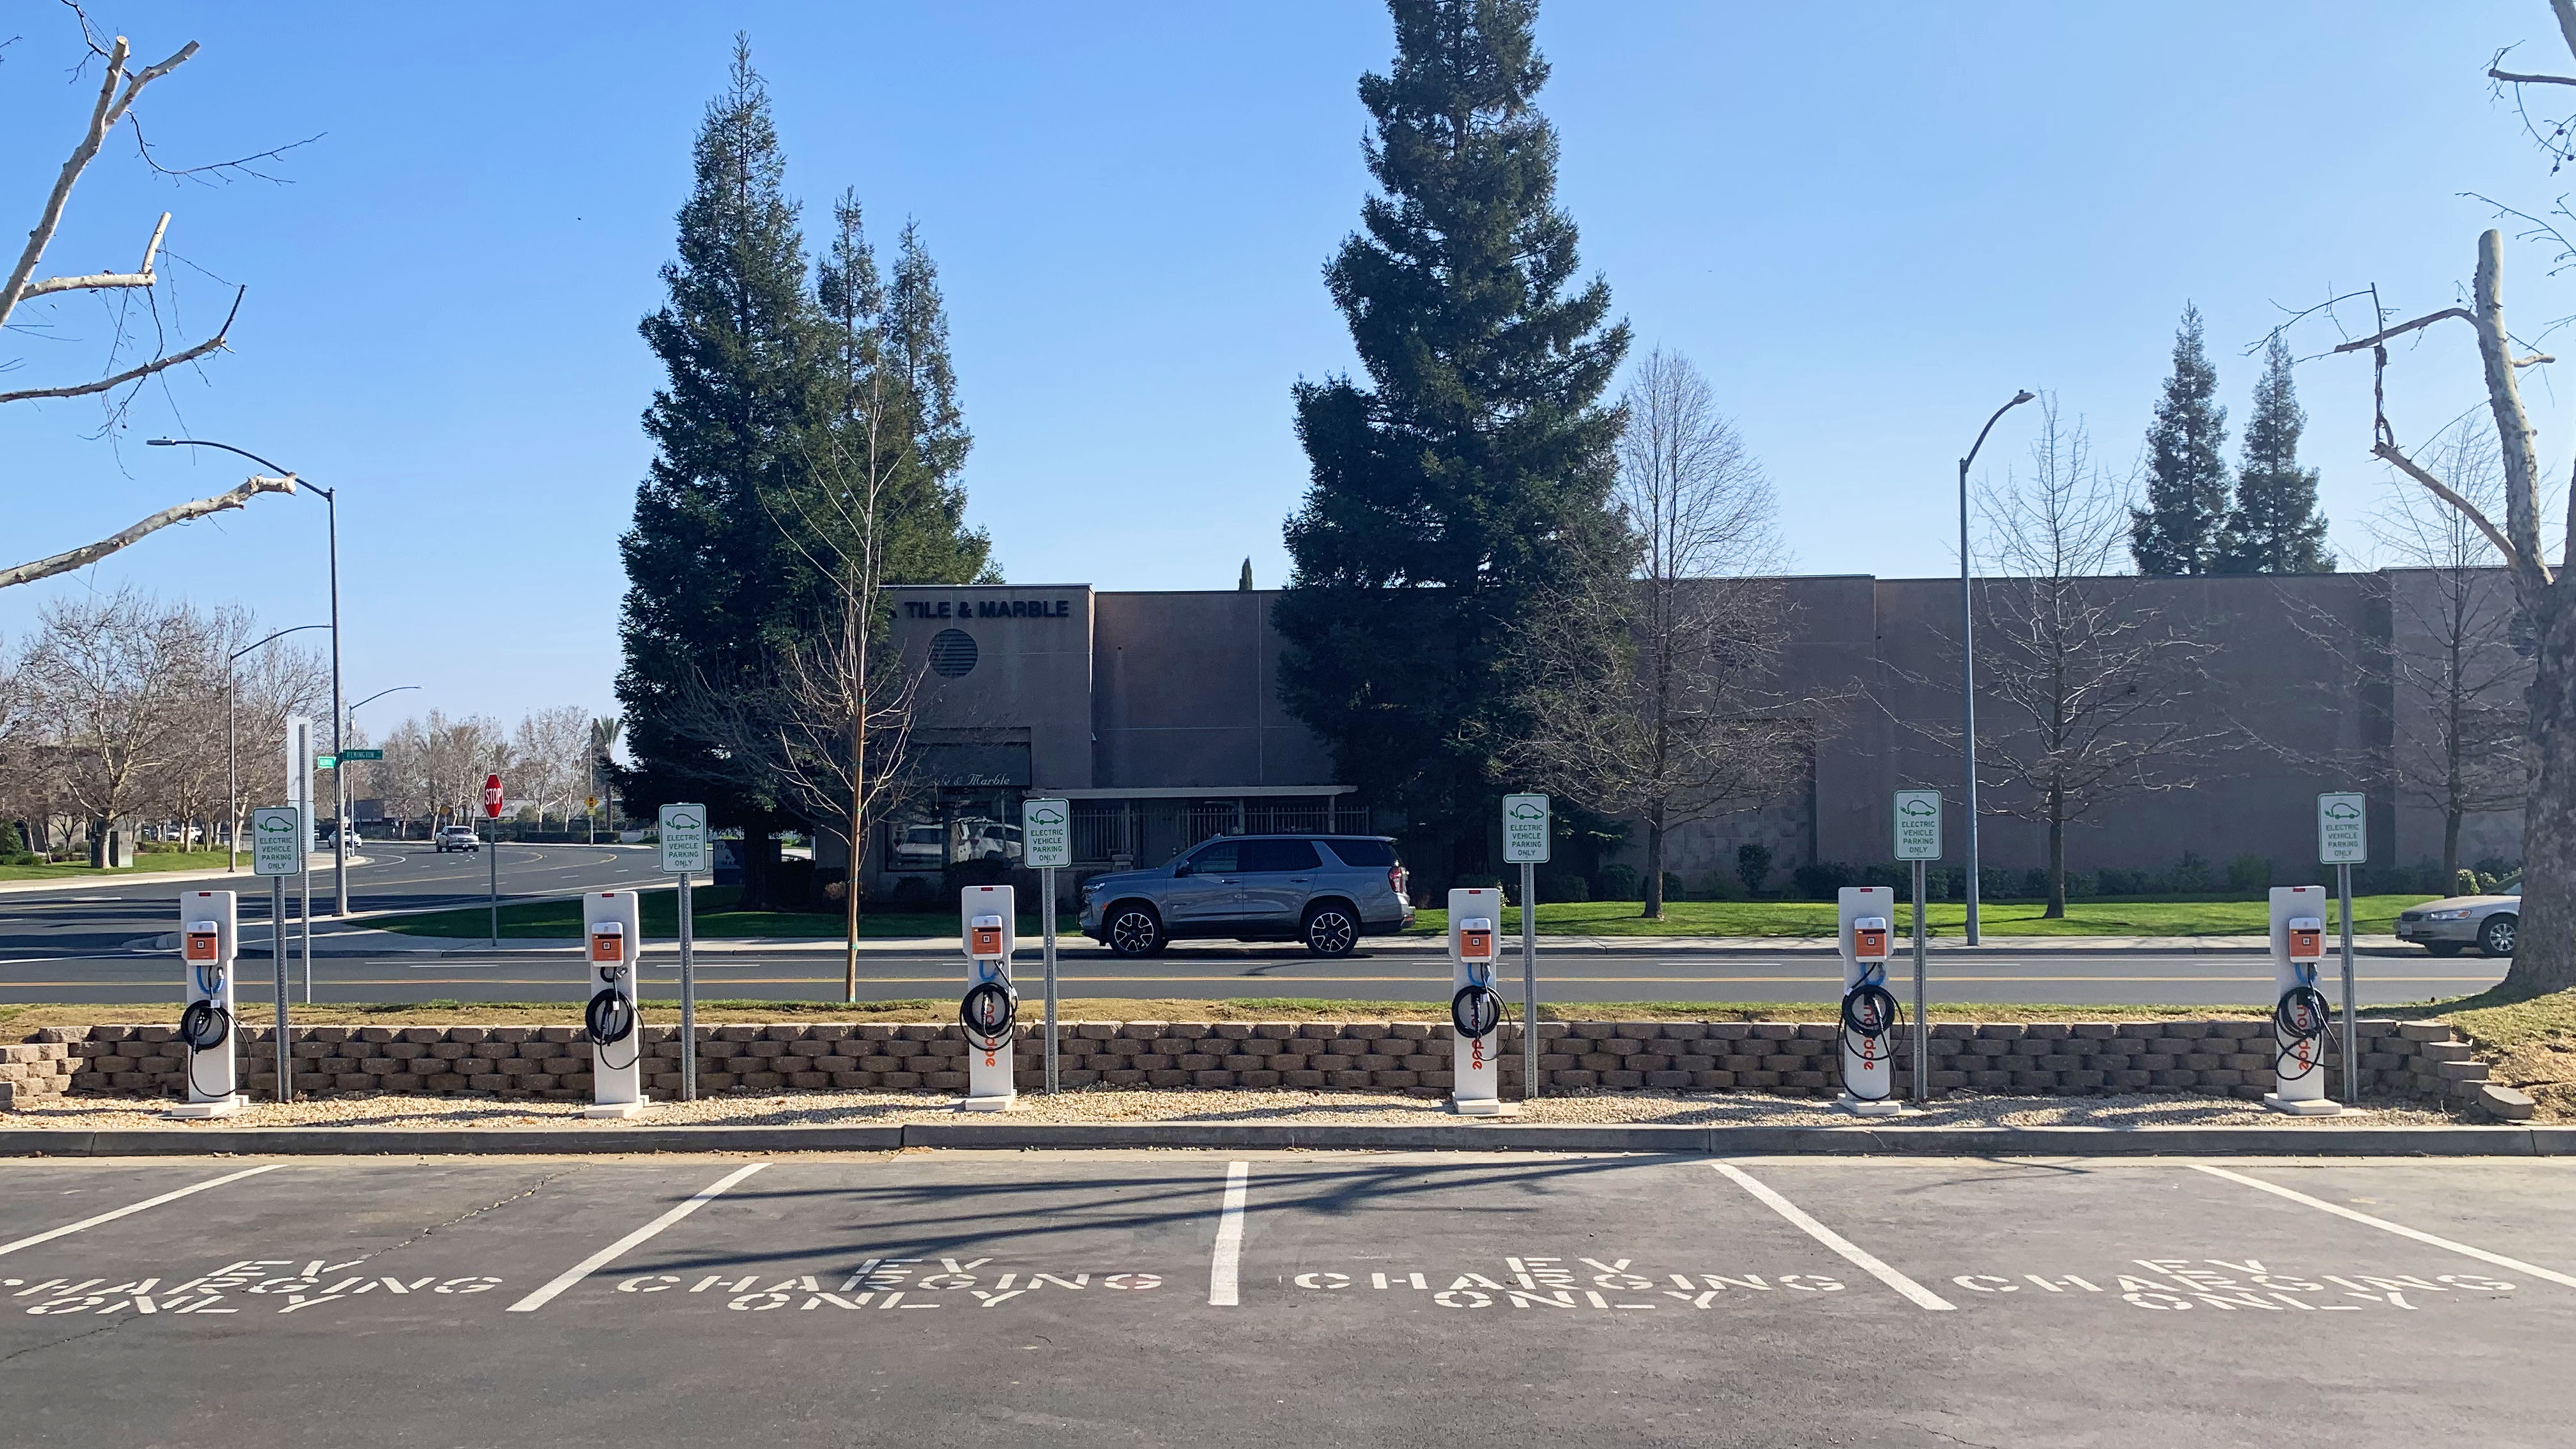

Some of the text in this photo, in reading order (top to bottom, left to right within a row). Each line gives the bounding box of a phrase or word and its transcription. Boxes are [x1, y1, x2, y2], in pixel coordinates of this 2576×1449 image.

[904, 601, 951, 618] TILE
[958, 601, 973, 618] &
[979, 601, 1069, 618] MARBLE
[968, 773, 1011, 786] Marble
[486, 788, 502, 805] STOP
[206, 1260, 364, 1276] EV
[855, 1258, 993, 1275] EV
[1505, 1257, 1632, 1273] EV
[2131, 1259, 2269, 1275] EV
[617, 1273, 1162, 1292] CHARGING
[1294, 1273, 1846, 1291] CHARGING
[1952, 1275, 2516, 1292] CHARGING
[26, 1294, 346, 1314] ONLY
[727, 1290, 1027, 1311] ONLY
[1434, 1290, 1720, 1309] ONLY
[2121, 1292, 2419, 1310] ONLY
